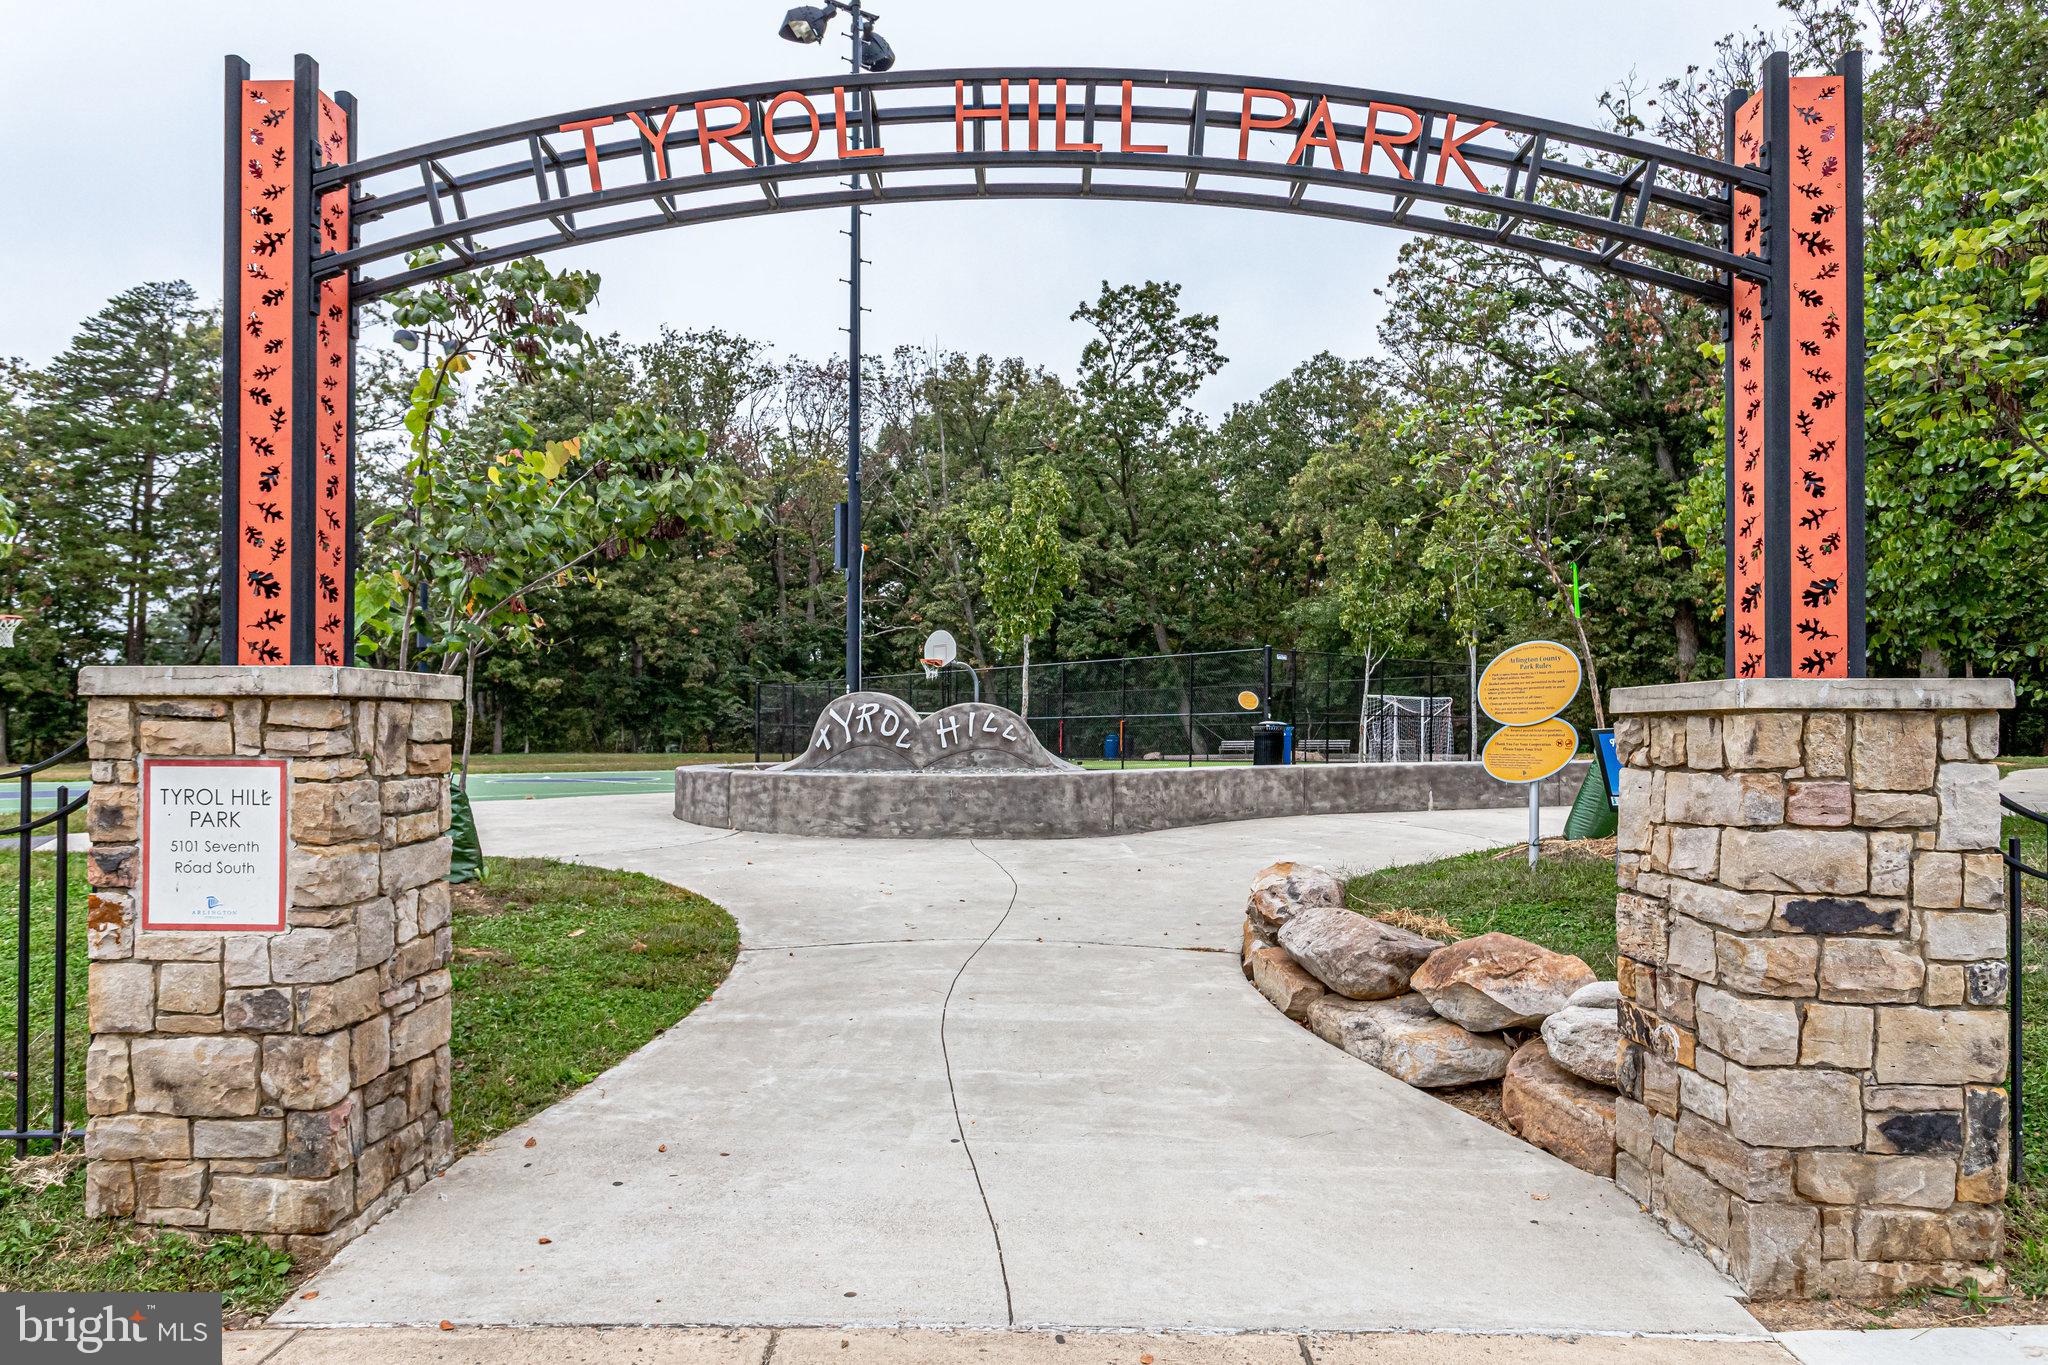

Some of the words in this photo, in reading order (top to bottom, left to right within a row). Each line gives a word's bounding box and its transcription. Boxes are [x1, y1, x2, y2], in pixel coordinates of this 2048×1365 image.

[559, 86, 885, 192] TYROL
[955, 78, 1168, 152] HILL
[1238, 87, 1499, 194] PARK
[815, 703, 911, 750] TYROL
[936, 712, 1018, 749] HILL
[160, 788, 224, 806] TYROL
[231, 788, 270, 806] HILL
[190, 811, 241, 828] PARK
[170, 840, 199, 852] 5101
[204, 840, 260, 853] Seventh
[174, 861, 212, 874] Road
[216, 861, 255, 874] South
